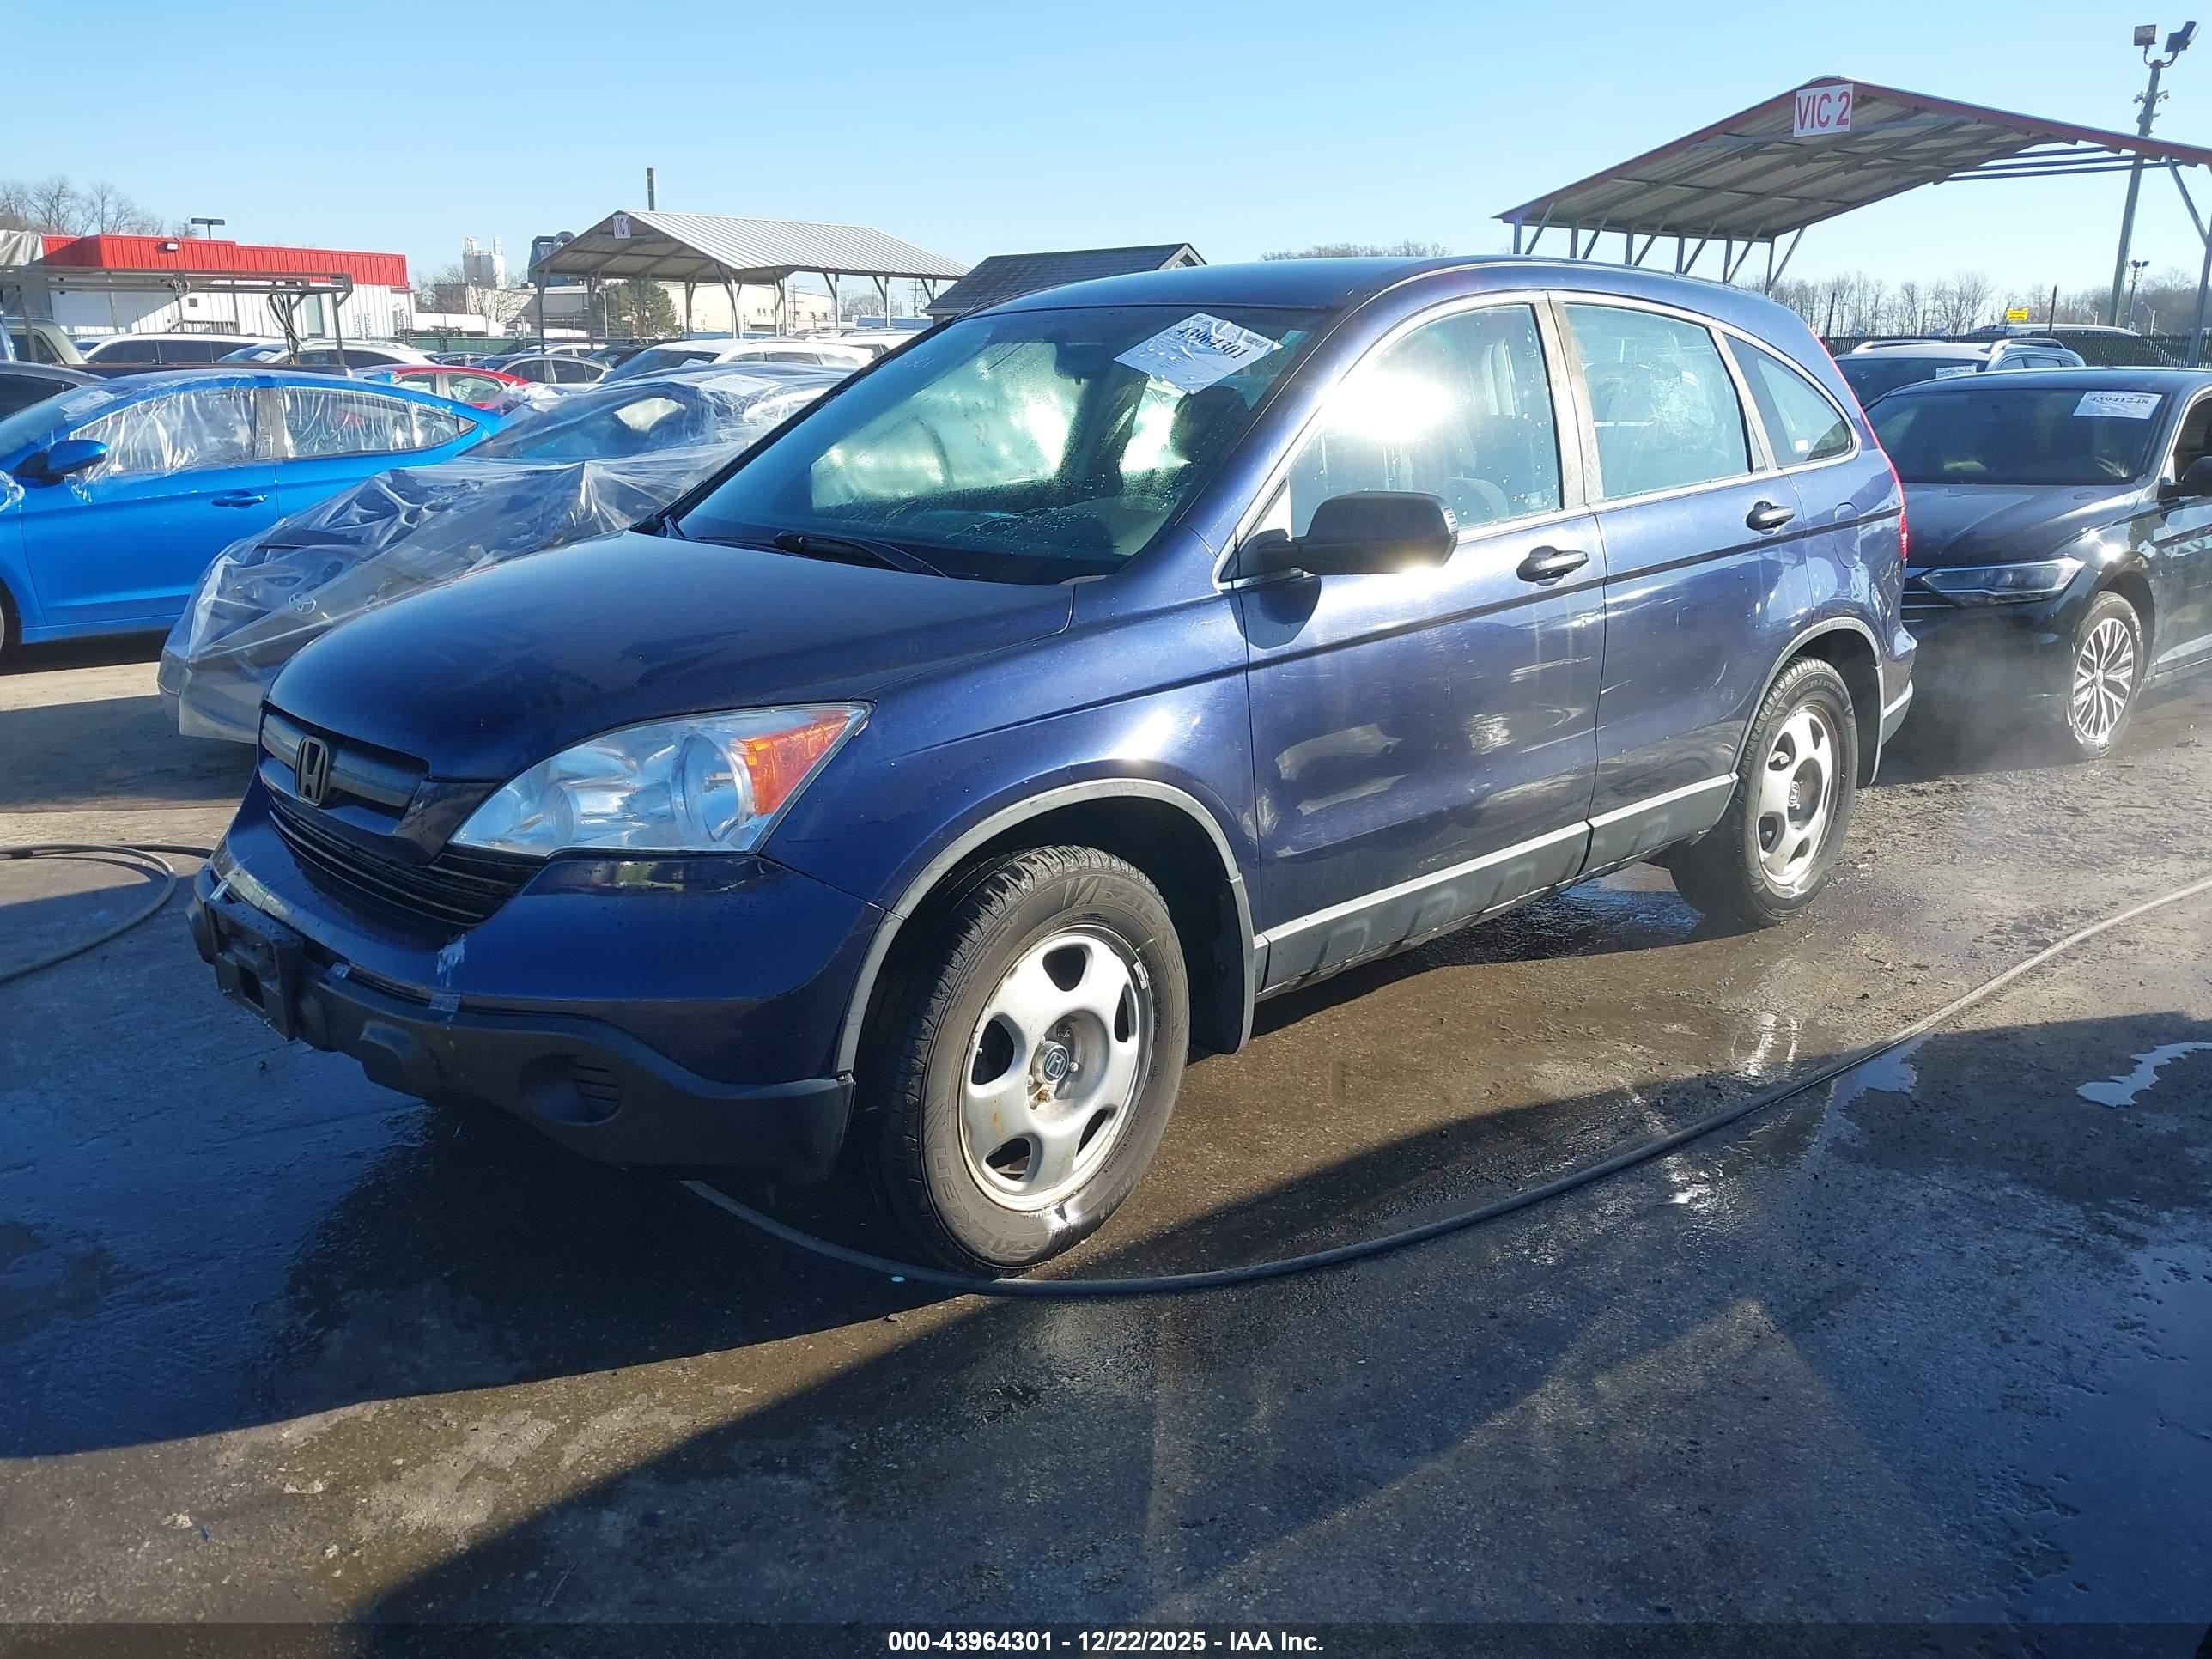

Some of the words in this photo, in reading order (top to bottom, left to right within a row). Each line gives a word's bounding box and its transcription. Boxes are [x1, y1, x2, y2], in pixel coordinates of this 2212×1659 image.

[1796, 93, 1832, 131] VIC
[1836, 91, 1850, 125] 2
[613, 217, 626, 235] VIC
[1176, 326, 1249, 360] 43964301
